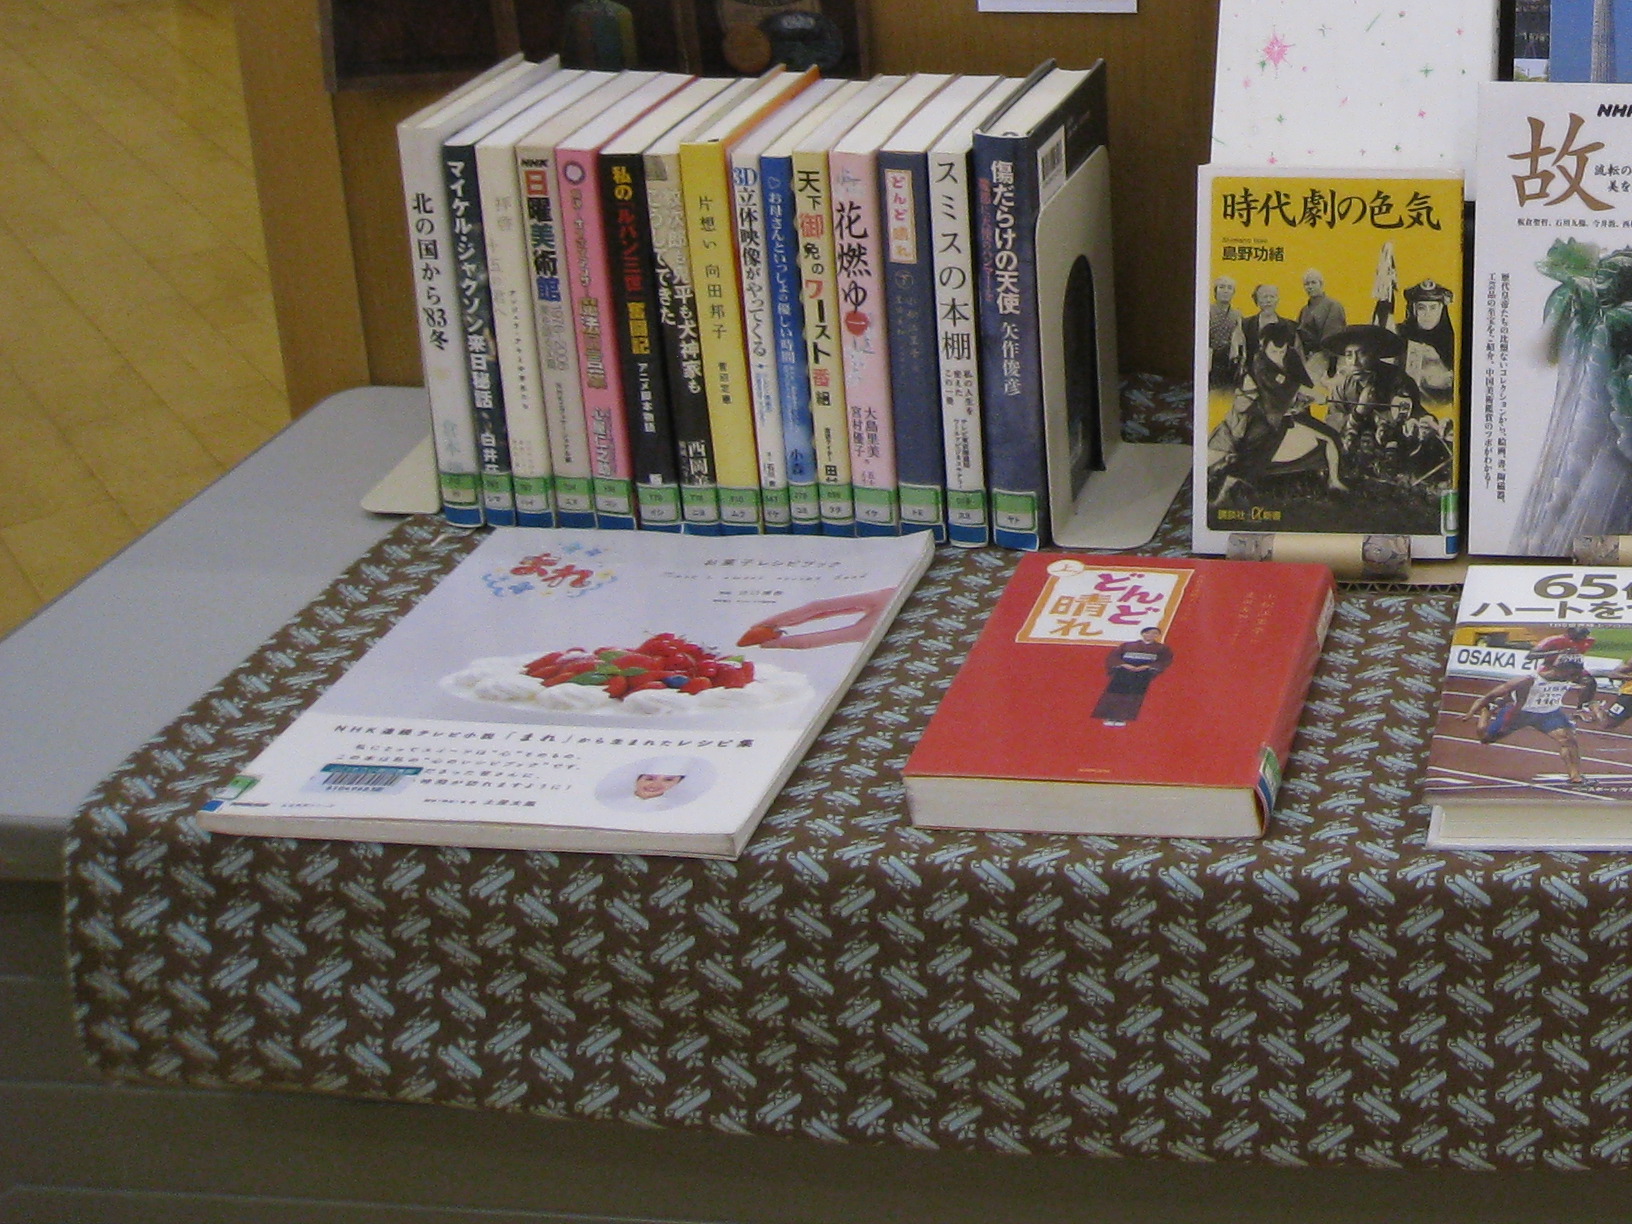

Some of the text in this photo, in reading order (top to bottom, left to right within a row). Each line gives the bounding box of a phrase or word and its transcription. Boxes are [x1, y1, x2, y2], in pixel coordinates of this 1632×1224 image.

[1506, 113, 1615, 212] 故
[1221, 187, 1442, 231] 時代劇の色気
[731, 166, 766, 358] 3D立体映像がやってくる
[834, 200, 871, 314] 花燃ゆ
[934, 161, 971, 361] スミスの本棚
[989, 159, 1023, 396] 傷だらけの天使 矢作俊彦
[704, 263, 731, 340] 向田邦子
[509, 553, 594, 589] まれ
[1095, 572, 1167, 626] どんど
[1049, 593, 1115, 638] 晴れ
[1456, 648, 1517, 670] OSAKA
